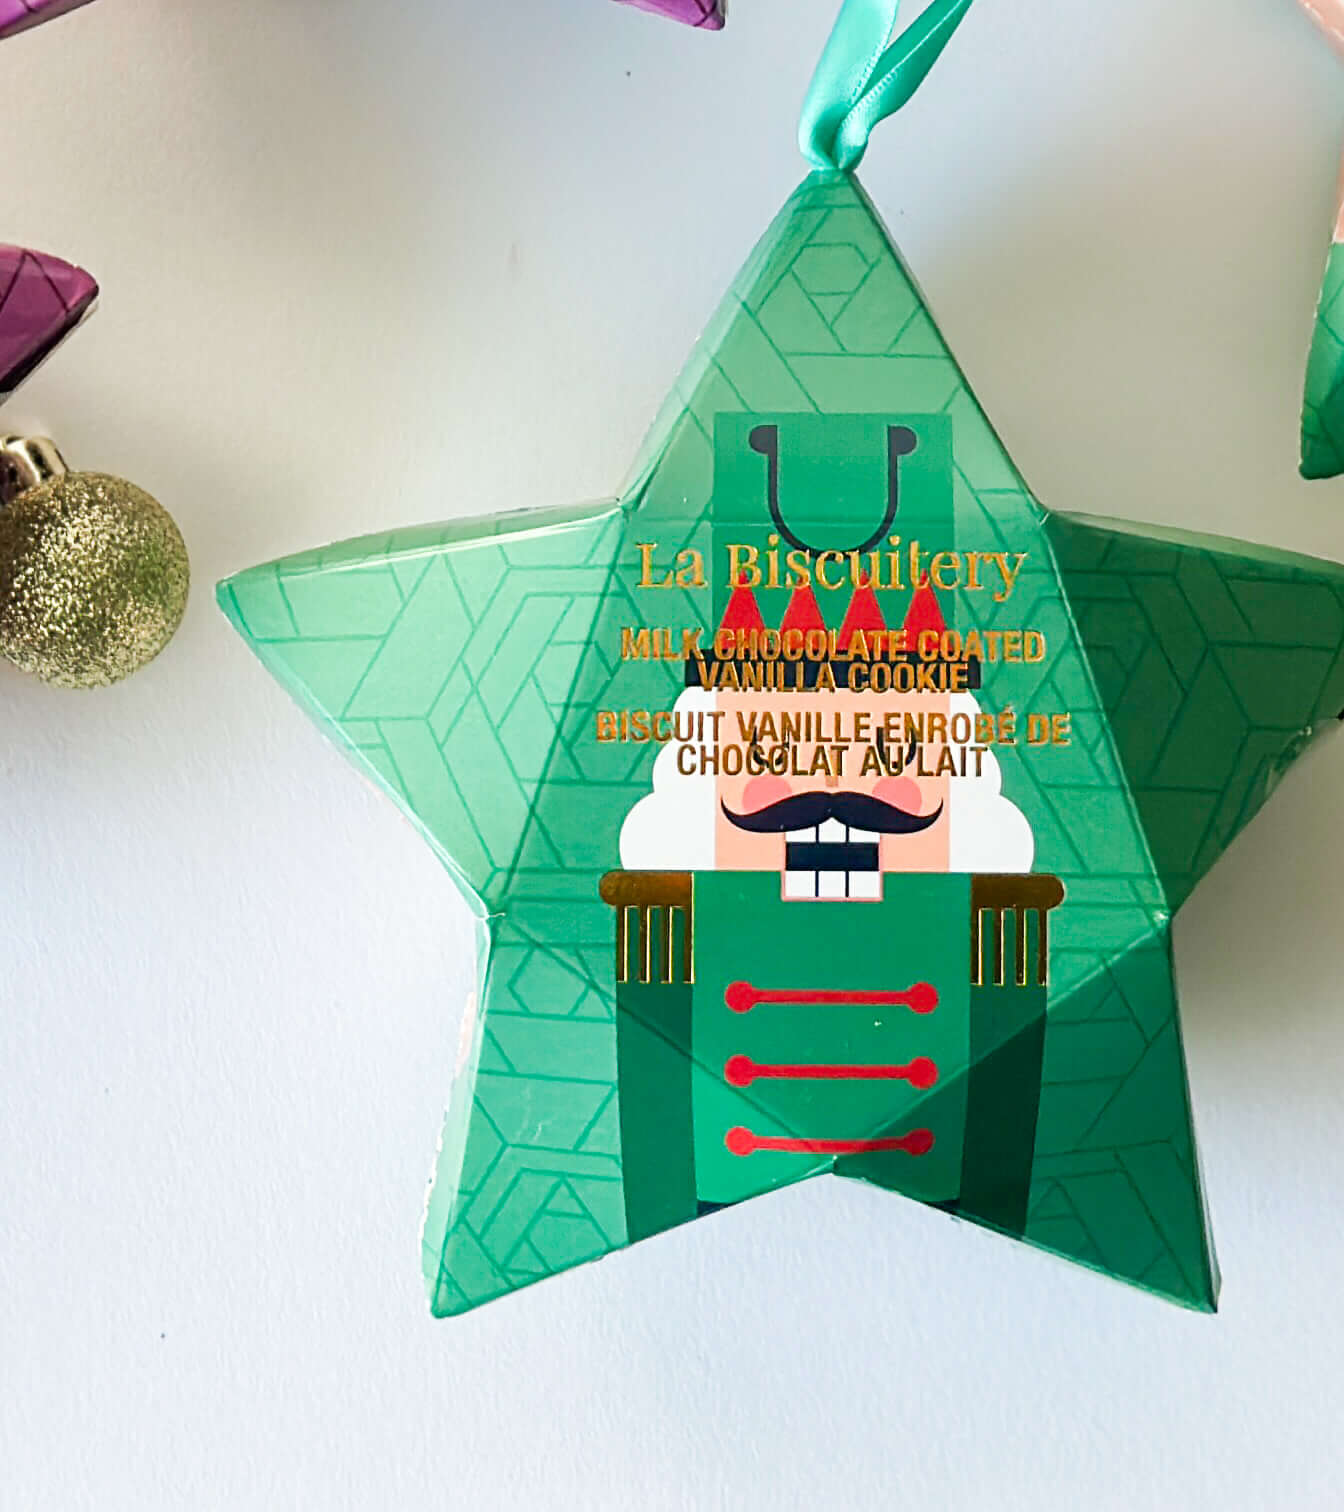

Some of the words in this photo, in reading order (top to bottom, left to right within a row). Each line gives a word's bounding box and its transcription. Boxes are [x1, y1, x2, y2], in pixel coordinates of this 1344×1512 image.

[635, 542, 707, 589] La
[725, 534, 1028, 602] Biscuitery
[621, 626, 705, 661] MILK
[714, 627, 909, 662] CHOCOLATE
[918, 629, 1046, 662] COATED
[698, 661, 837, 693] VANILLA
[847, 662, 971, 694] COOKIE
[596, 710, 727, 743] BISCUIT
[737, 711, 873, 743] VANILLE
[882, 706, 1017, 745] ENROBÉ
[1024, 712, 1071, 745] DE
[677, 743, 850, 777] CHOCOLAT
[860, 744, 907, 777] AU
[916, 745, 989, 777] LAIT
